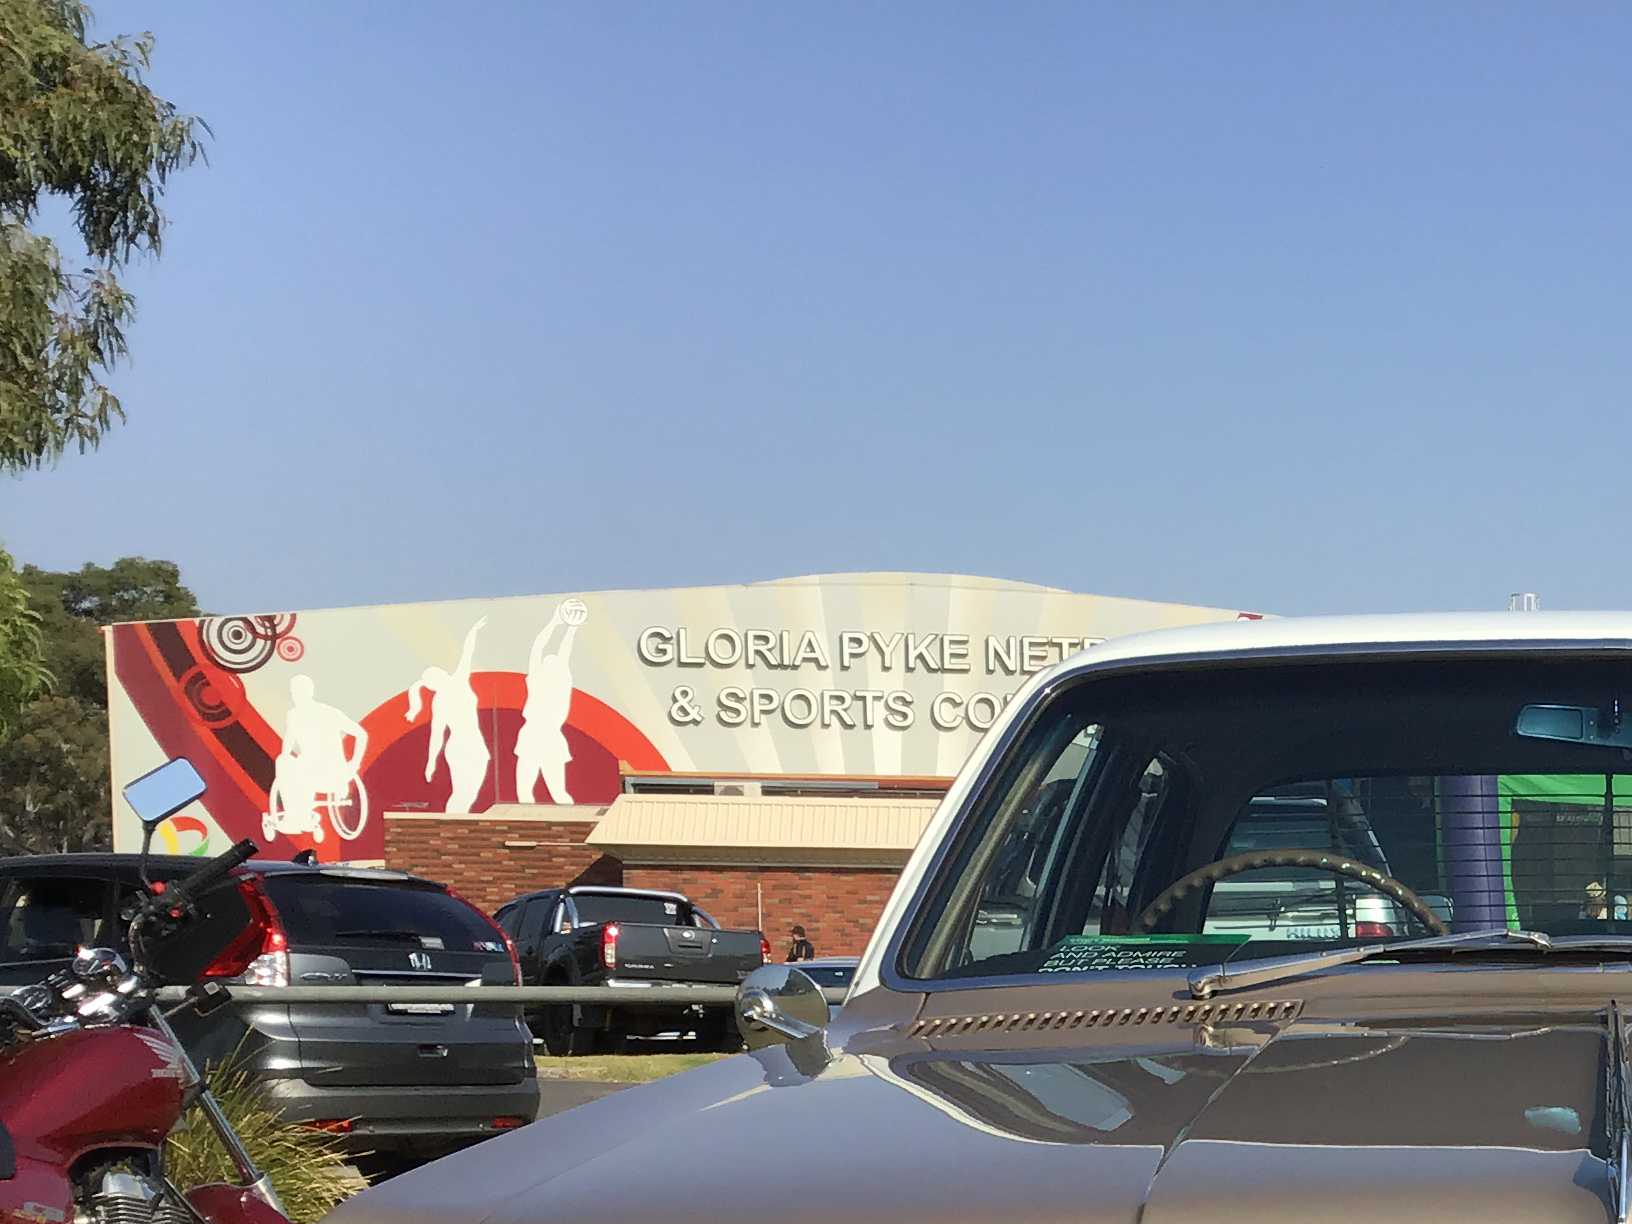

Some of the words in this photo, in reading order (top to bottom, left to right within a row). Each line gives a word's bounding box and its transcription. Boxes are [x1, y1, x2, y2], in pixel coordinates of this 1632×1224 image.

[637, 625, 829, 670] GLORIA
[839, 630, 973, 674] PYKE
[667, 684, 704, 727] &
[715, 685, 915, 731] SPORTS
[931, 691, 1014, 732] CO
[1043, 958, 1089, 967] BUT
[1092, 957, 1176, 966] PLEASE
[1049, 951, 1098, 960] AND
[1102, 950, 1187, 958] ADMIRE
